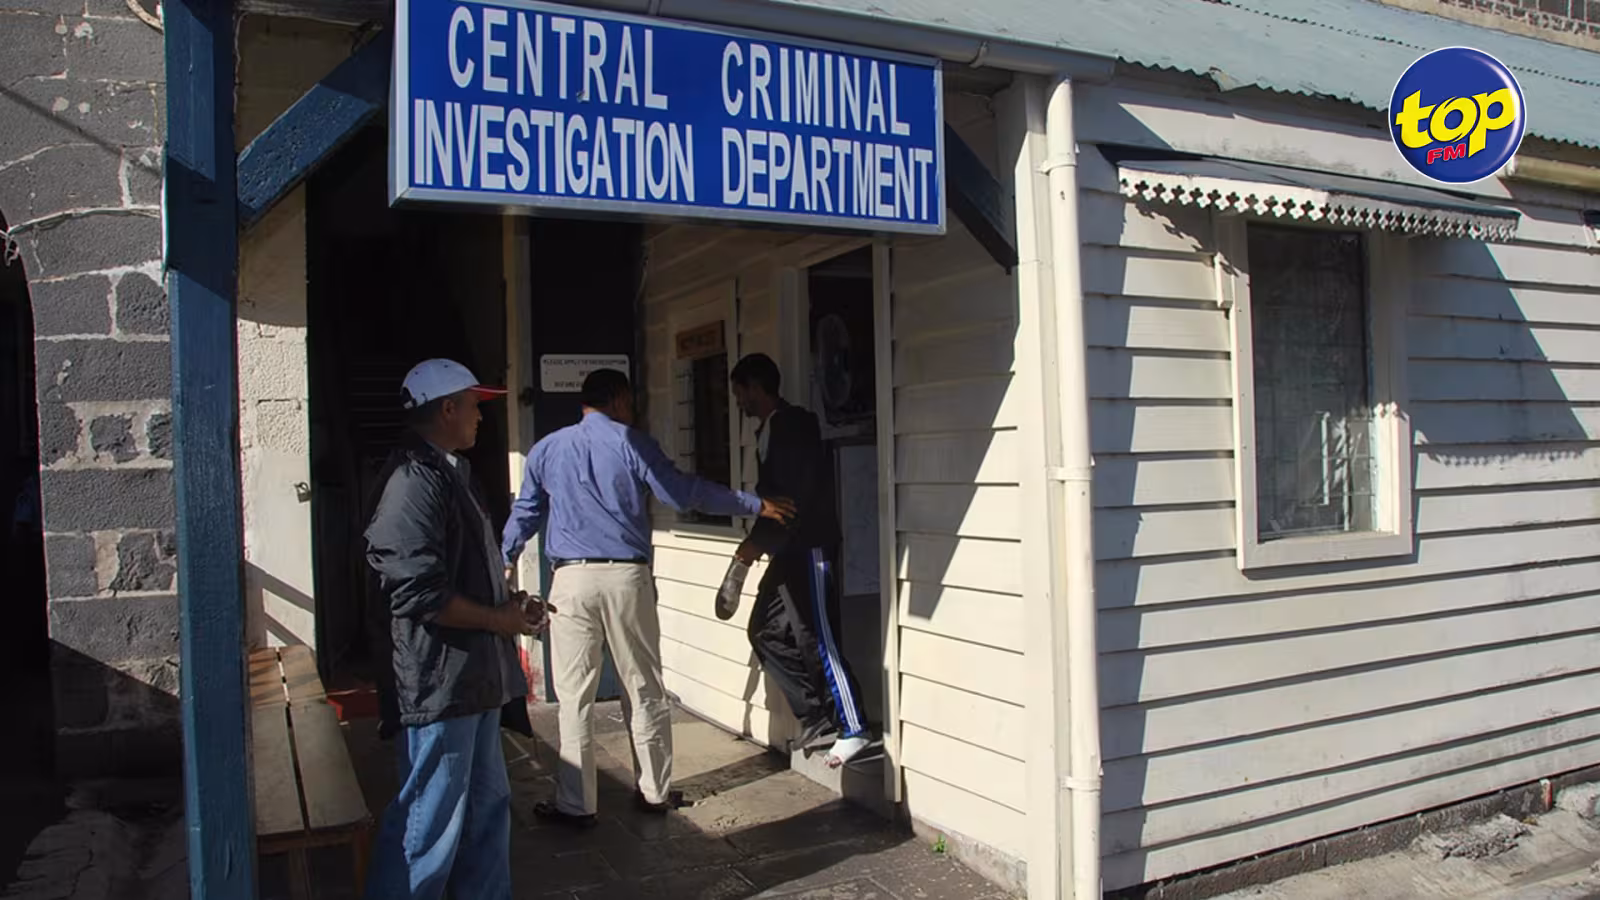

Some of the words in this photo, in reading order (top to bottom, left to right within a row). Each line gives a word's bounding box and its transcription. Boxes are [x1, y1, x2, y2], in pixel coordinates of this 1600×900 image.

[448, 5, 668, 110] CENTRAL
[721, 41, 911, 136] CRIMINAL
[414, 99, 695, 202] INVESTIGATION
[722, 127, 933, 221] DEPARTMENT
